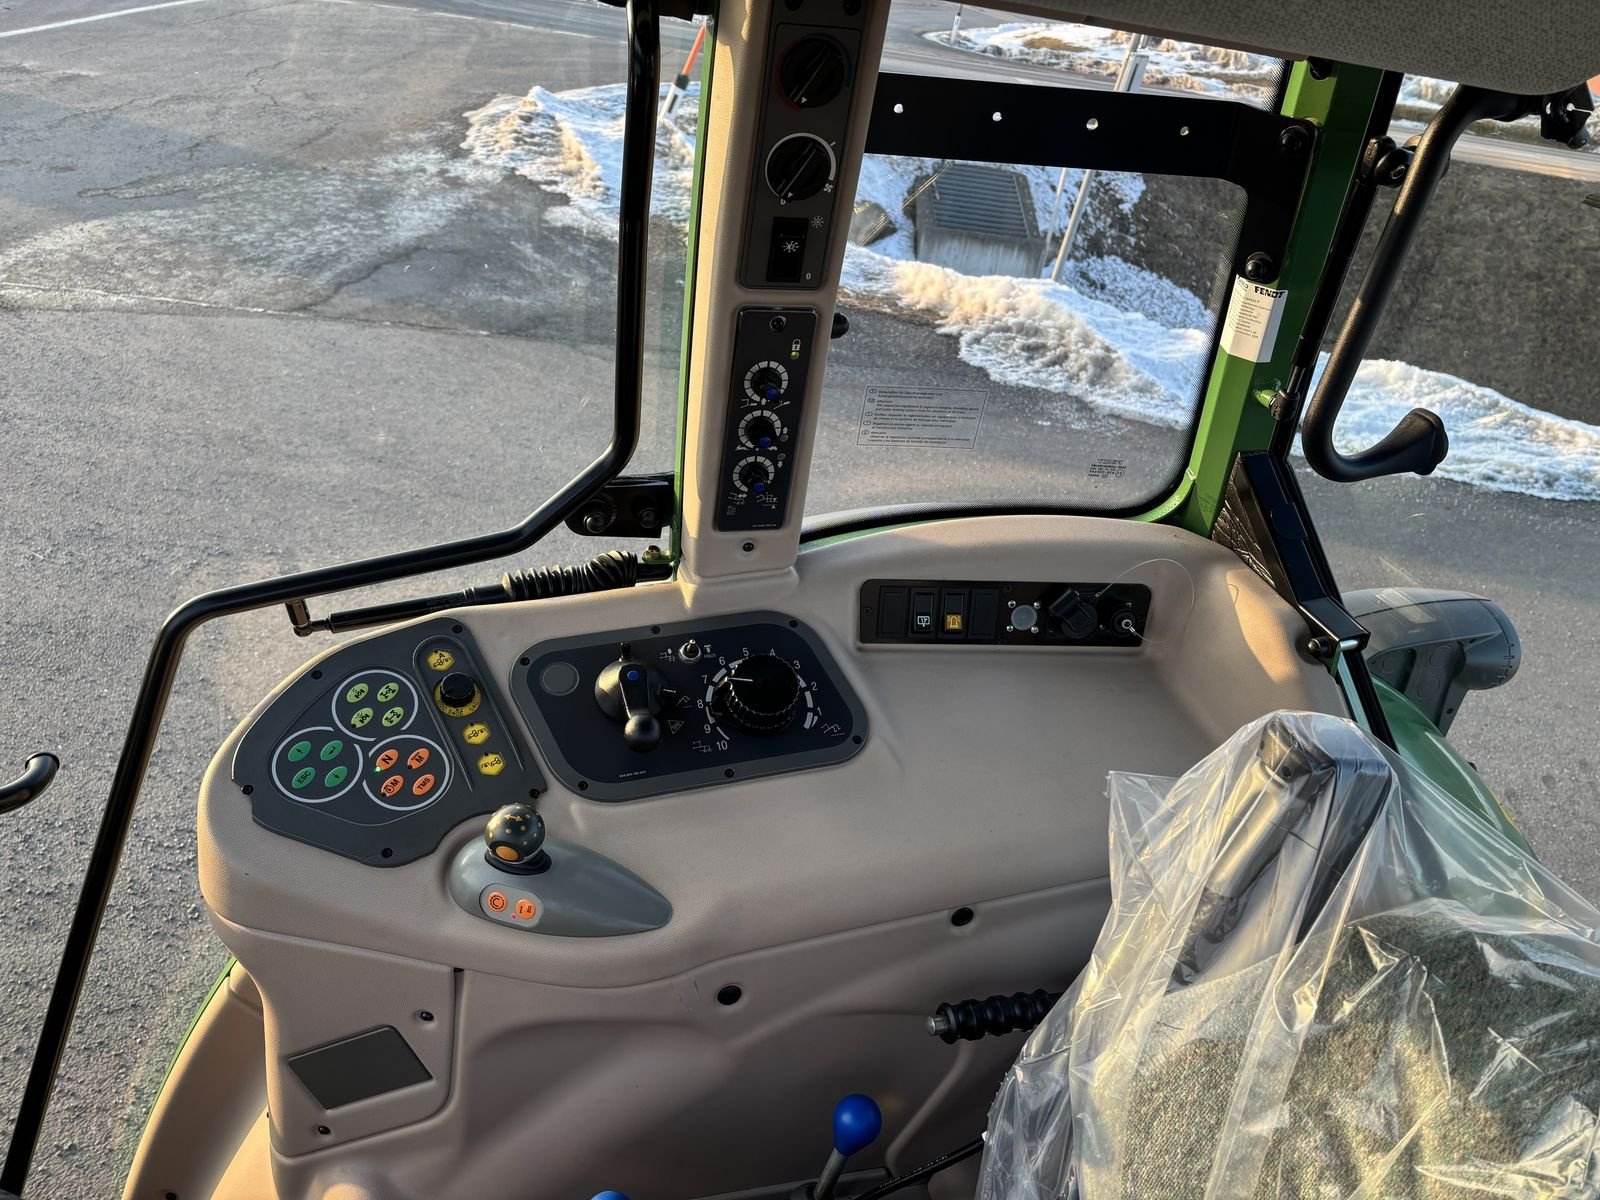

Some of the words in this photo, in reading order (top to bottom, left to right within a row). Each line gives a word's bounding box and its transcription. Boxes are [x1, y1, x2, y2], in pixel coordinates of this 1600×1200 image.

[805, 272, 812, 280] 0
[1254, 286, 1286, 298] FENDT
[742, 647, 749, 657] 5
[769, 648, 776, 657] 4
[718, 656, 726, 666] 6
[793, 660, 801, 669] 3
[701, 674, 708, 684] 7
[810, 682, 818, 691] 2
[469, 701, 479, 712] 540
[696, 699, 704, 709] 8
[816, 706, 822, 716] 1
[703, 724, 711, 734] 9
[716, 740, 728, 751] 10
[381, 754, 394, 765] N
[415, 755, 425, 764] M
[297, 770, 312, 784] ESC
[390, 778, 400, 787] M
[417, 777, 431, 790] TMS
